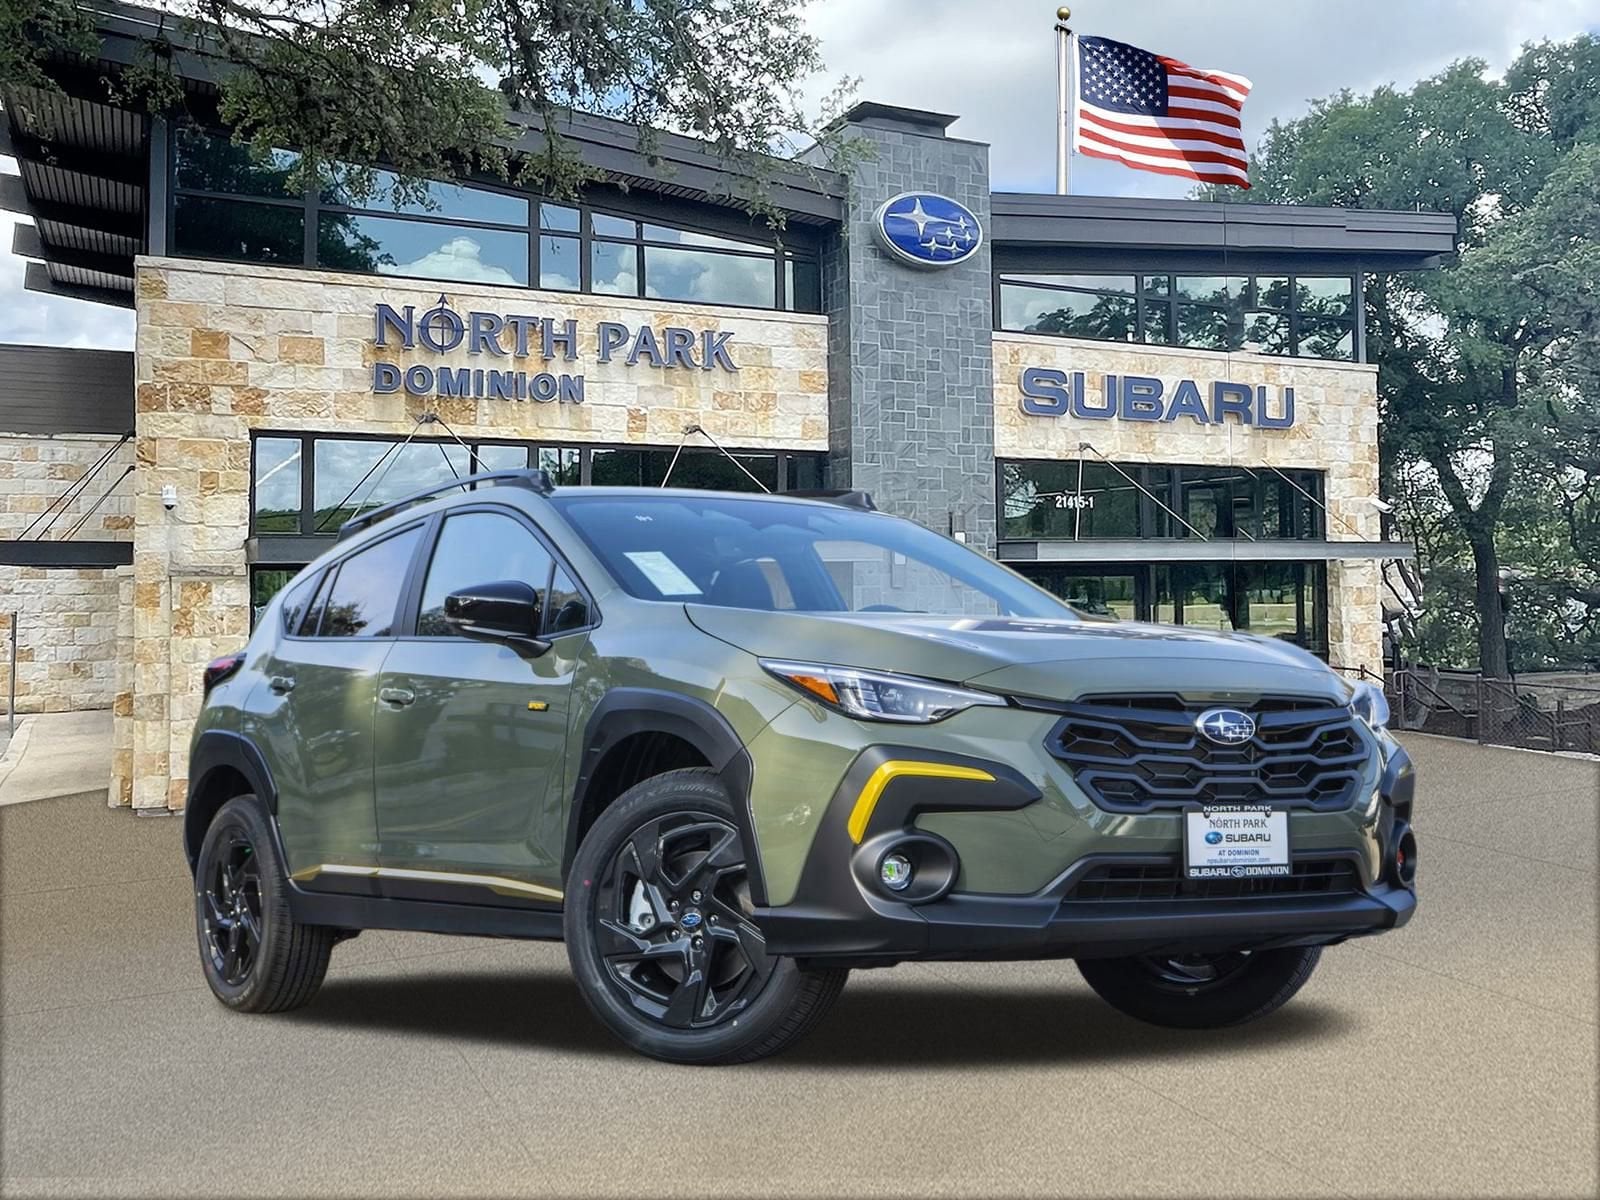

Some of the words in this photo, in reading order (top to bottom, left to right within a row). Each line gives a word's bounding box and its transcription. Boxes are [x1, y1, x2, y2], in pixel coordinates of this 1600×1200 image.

[374, 293, 579, 361] NORTH
[597, 320, 742, 373] PARK
[373, 362, 585, 404] DOMINION
[1019, 367, 1294, 429] SUBARU
[1055, 495, 1094, 509] 21415-1
[1203, 805, 1241, 813] NORTH
[1244, 804, 1273, 812] PARK
[1209, 818, 1240, 829] NORTH
[1243, 818, 1268, 829] PARK
[1225, 833, 1272, 843] SUBARU
[1218, 849, 1226, 857] AT
[1227, 849, 1260, 857] DOMINION
[1189, 867, 1231, 878] SUBARU
[1245, 865, 1290, 876] DOMINION
